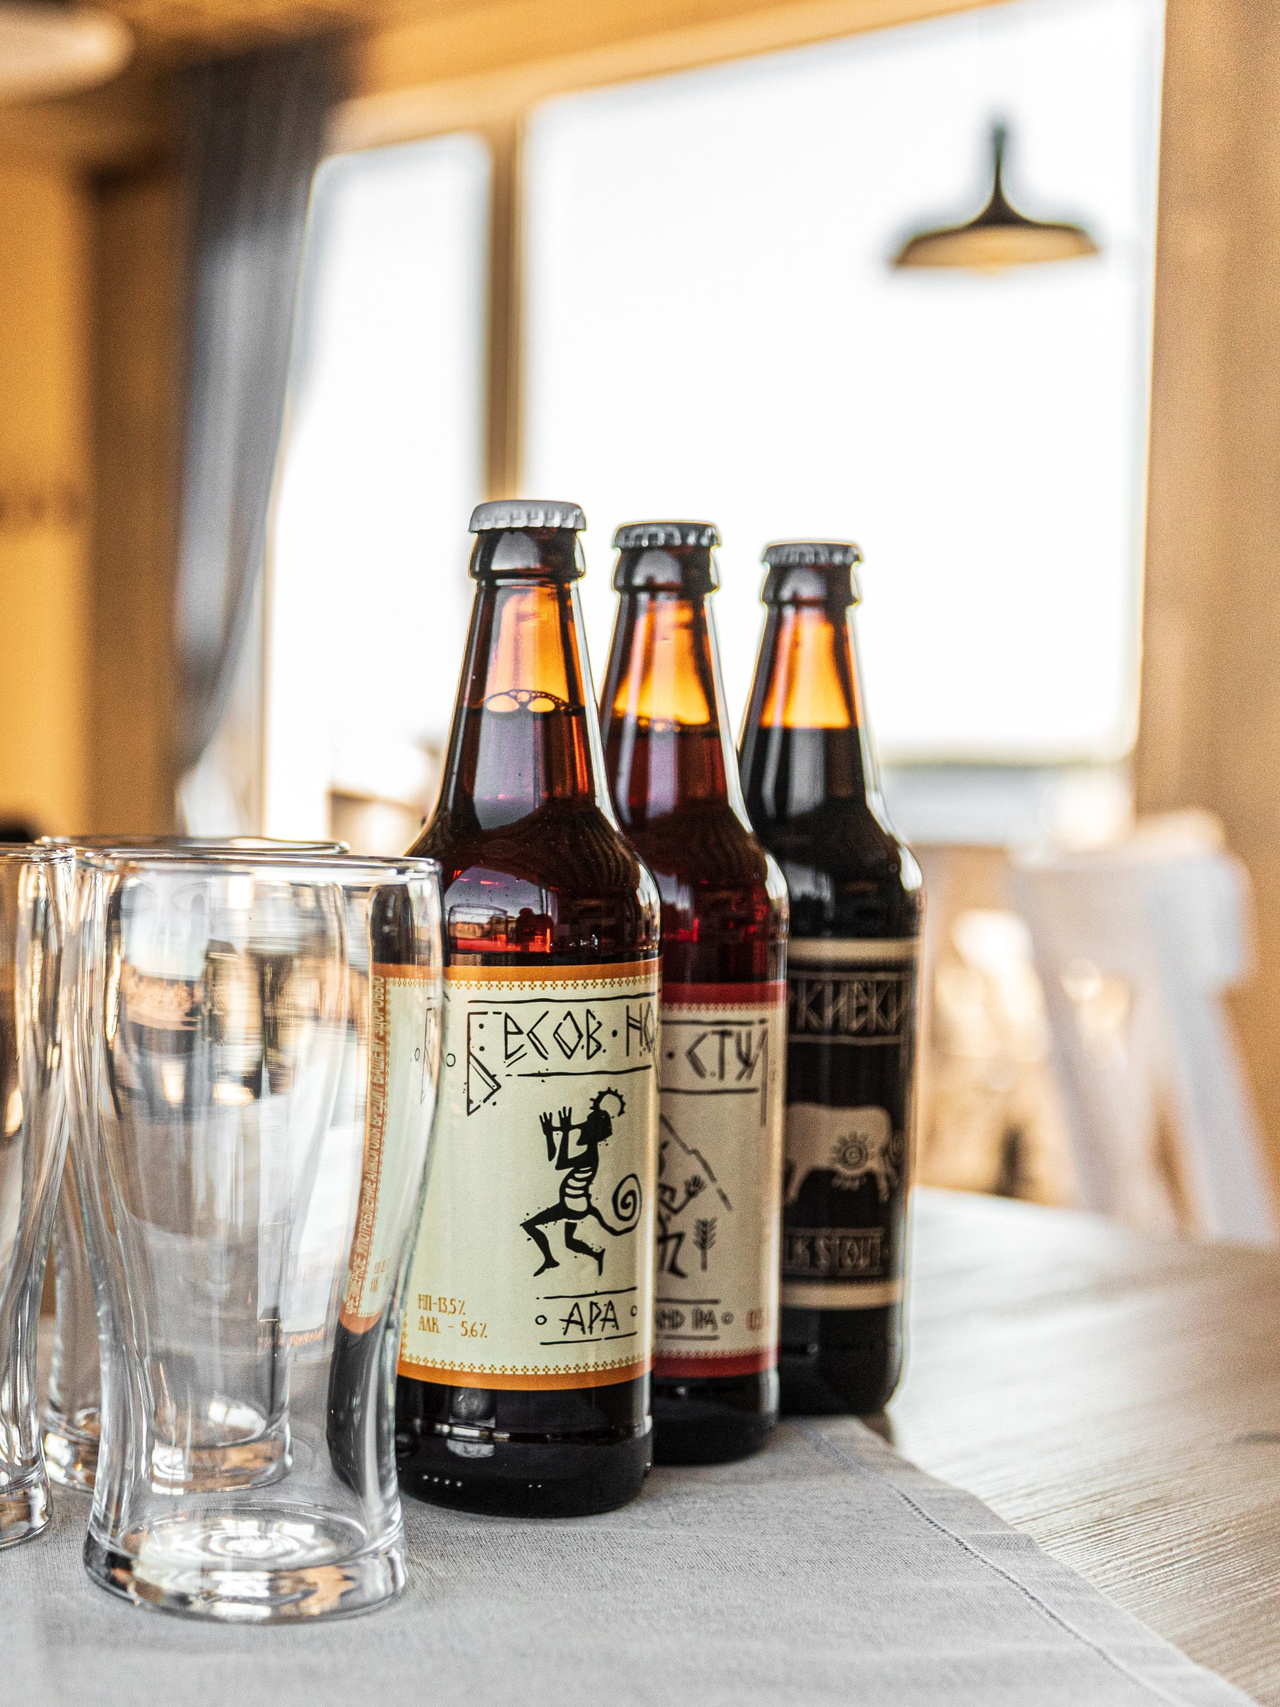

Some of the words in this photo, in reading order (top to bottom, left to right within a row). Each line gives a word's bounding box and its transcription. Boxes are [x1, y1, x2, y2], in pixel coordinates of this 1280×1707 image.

[463, 1008, 604, 1117] БЕСОВ
[418, 1315, 441, 1334] АЛК
[559, 1300, 620, 1335] APA
